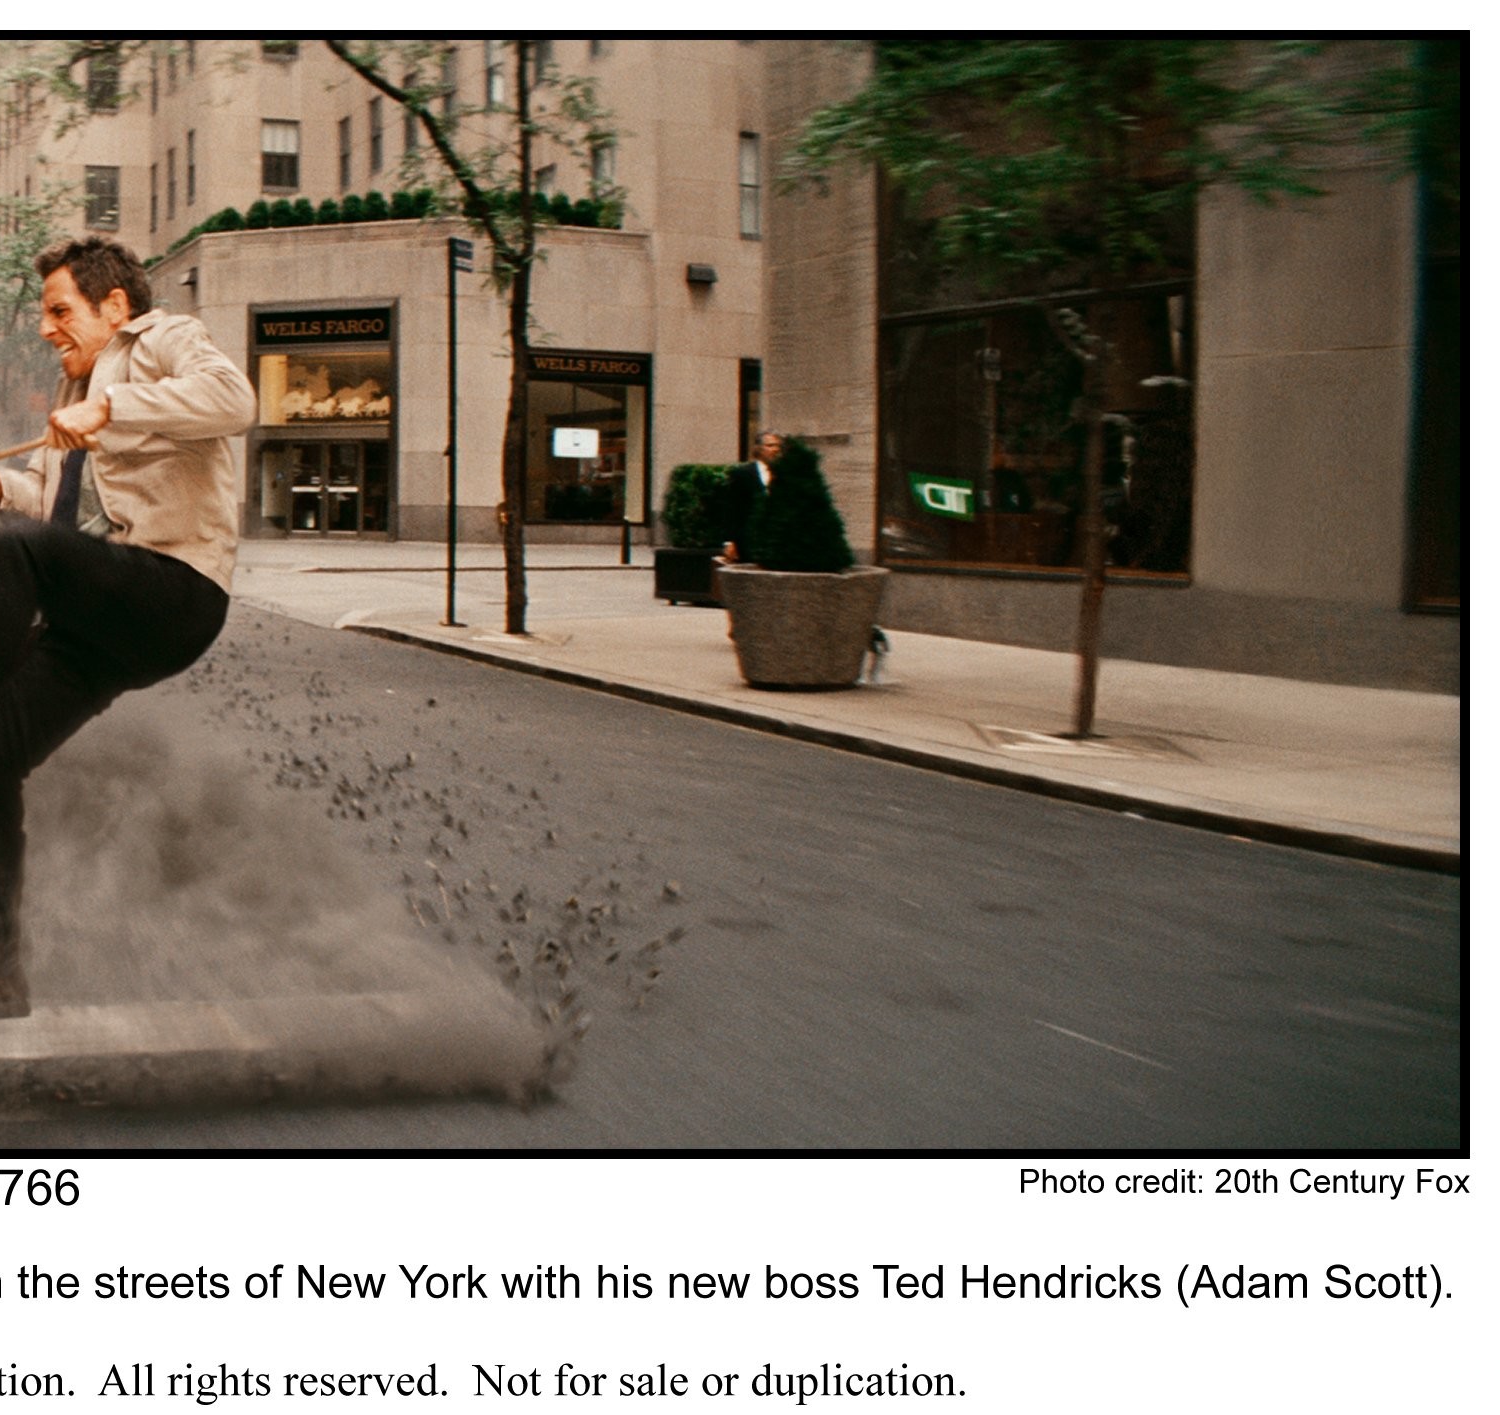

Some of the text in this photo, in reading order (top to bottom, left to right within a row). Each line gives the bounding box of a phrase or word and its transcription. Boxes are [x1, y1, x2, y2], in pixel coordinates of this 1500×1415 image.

[263, 318, 385, 336] WELLS FARGO
[534, 357, 640, 374] WELLS FARGO
